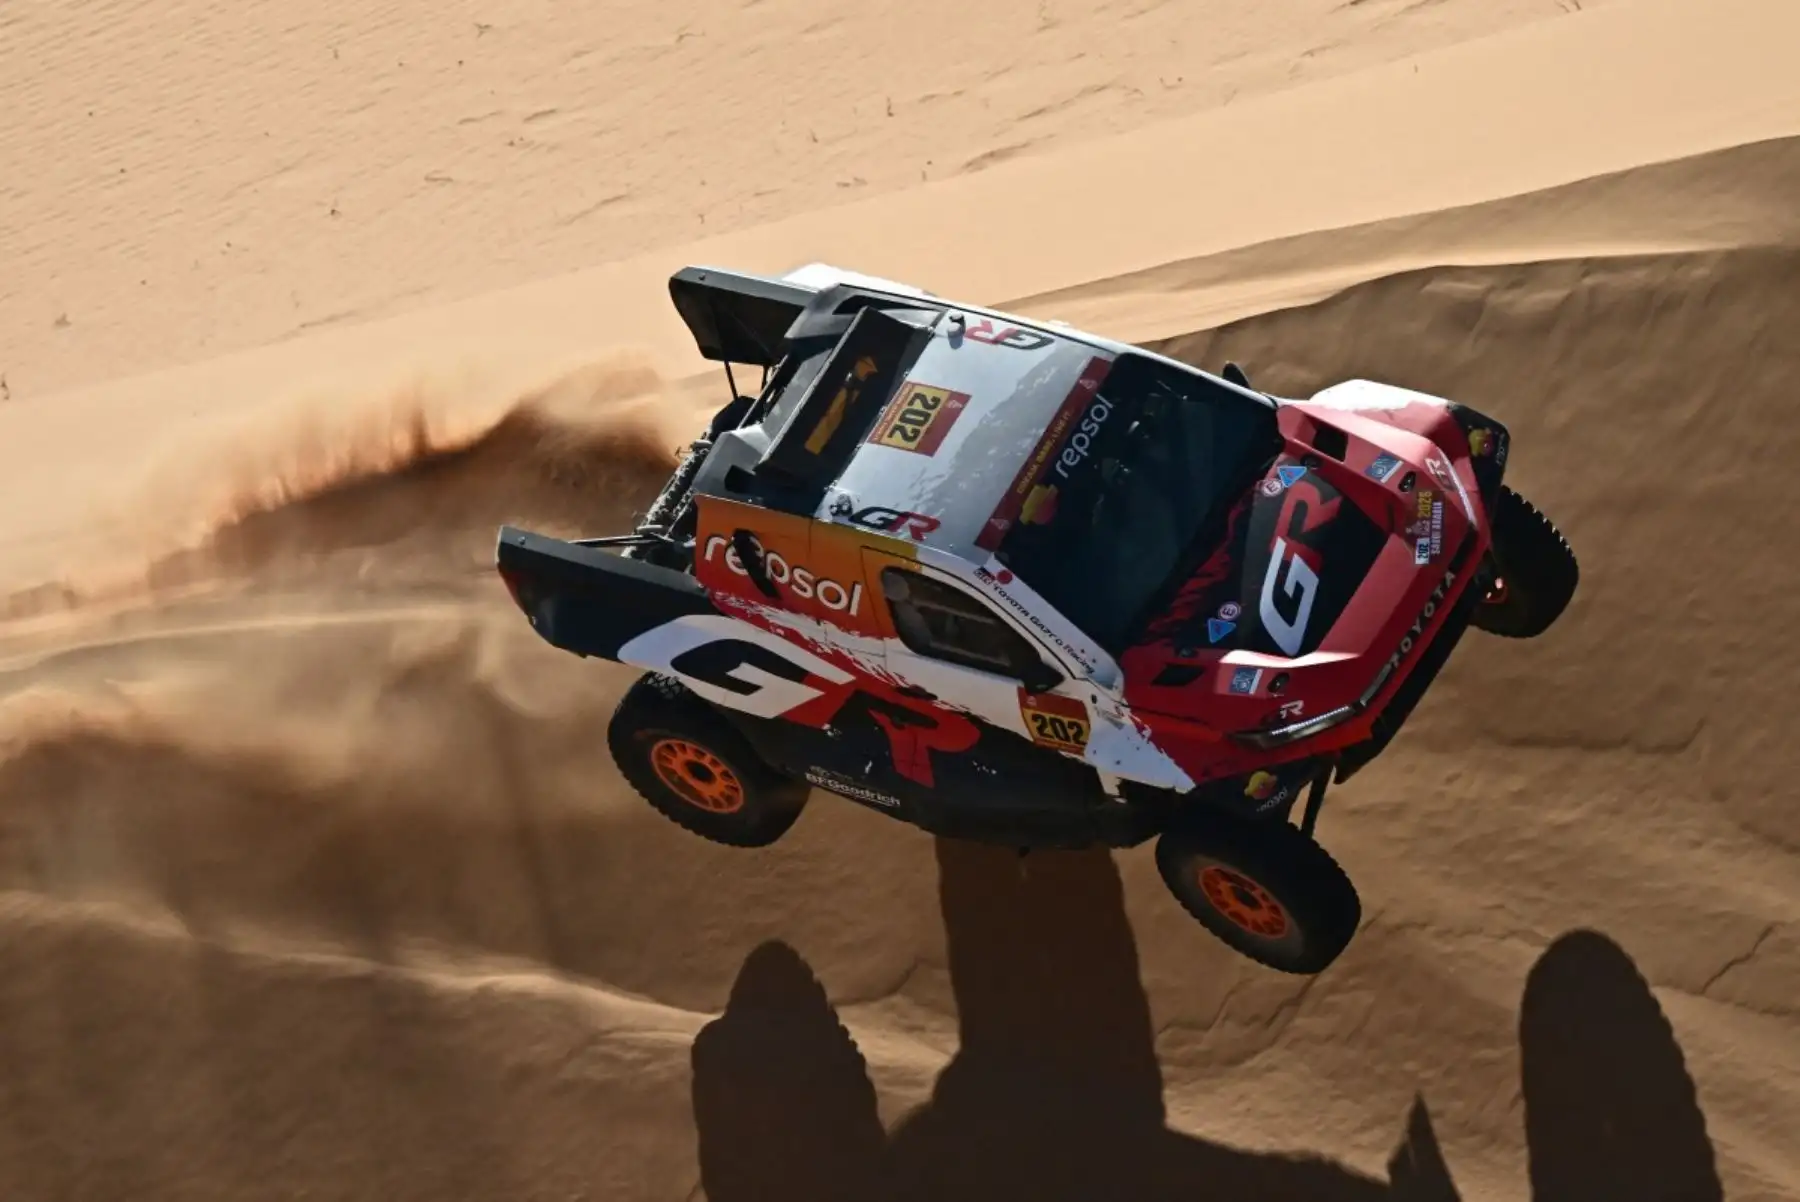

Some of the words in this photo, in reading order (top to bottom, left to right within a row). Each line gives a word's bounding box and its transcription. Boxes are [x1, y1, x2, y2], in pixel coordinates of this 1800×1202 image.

[964, 319, 1055, 350] GR
[888, 391, 941, 443] 202
[1055, 393, 1114, 478] repsol
[848, 506, 941, 541] GR
[1259, 480, 1344, 657] GR
[993, 583, 1030, 617] TOYOTA
[1063, 644, 1095, 675] Racing
[1389, 571, 1456, 669] TOYOTA
[617, 614, 981, 788] GR
[1031, 713, 1088, 746] 202
[1256, 786, 1289, 813] epsol
